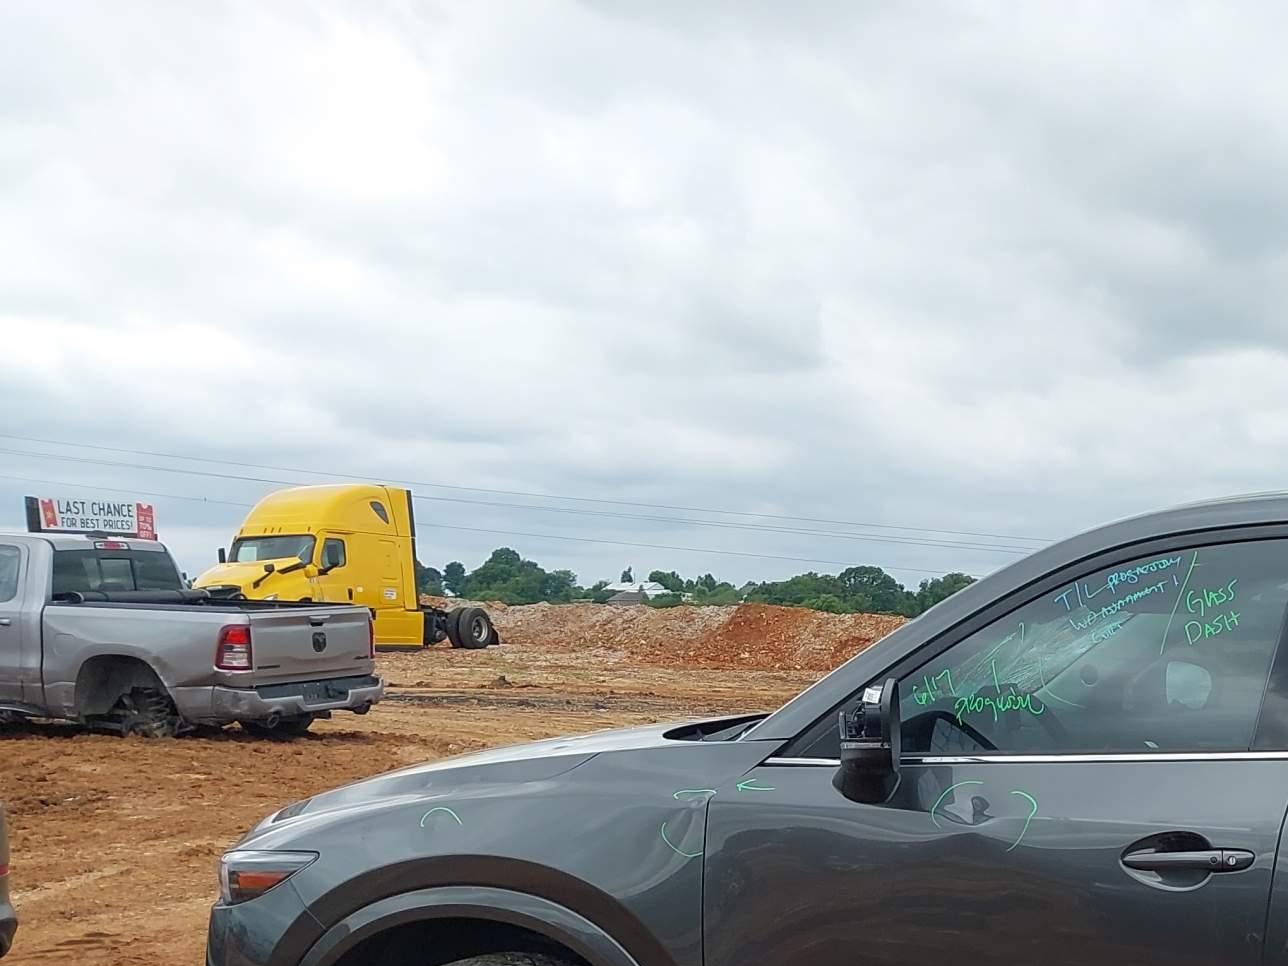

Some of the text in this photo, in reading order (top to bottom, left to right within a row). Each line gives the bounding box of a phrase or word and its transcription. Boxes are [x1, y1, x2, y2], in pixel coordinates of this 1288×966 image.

[57, 500, 134, 518] LAST CHANCE
[61, 516, 133, 530] FOR BEST PRICES!
[1184, 610, 1241, 646] DASH
